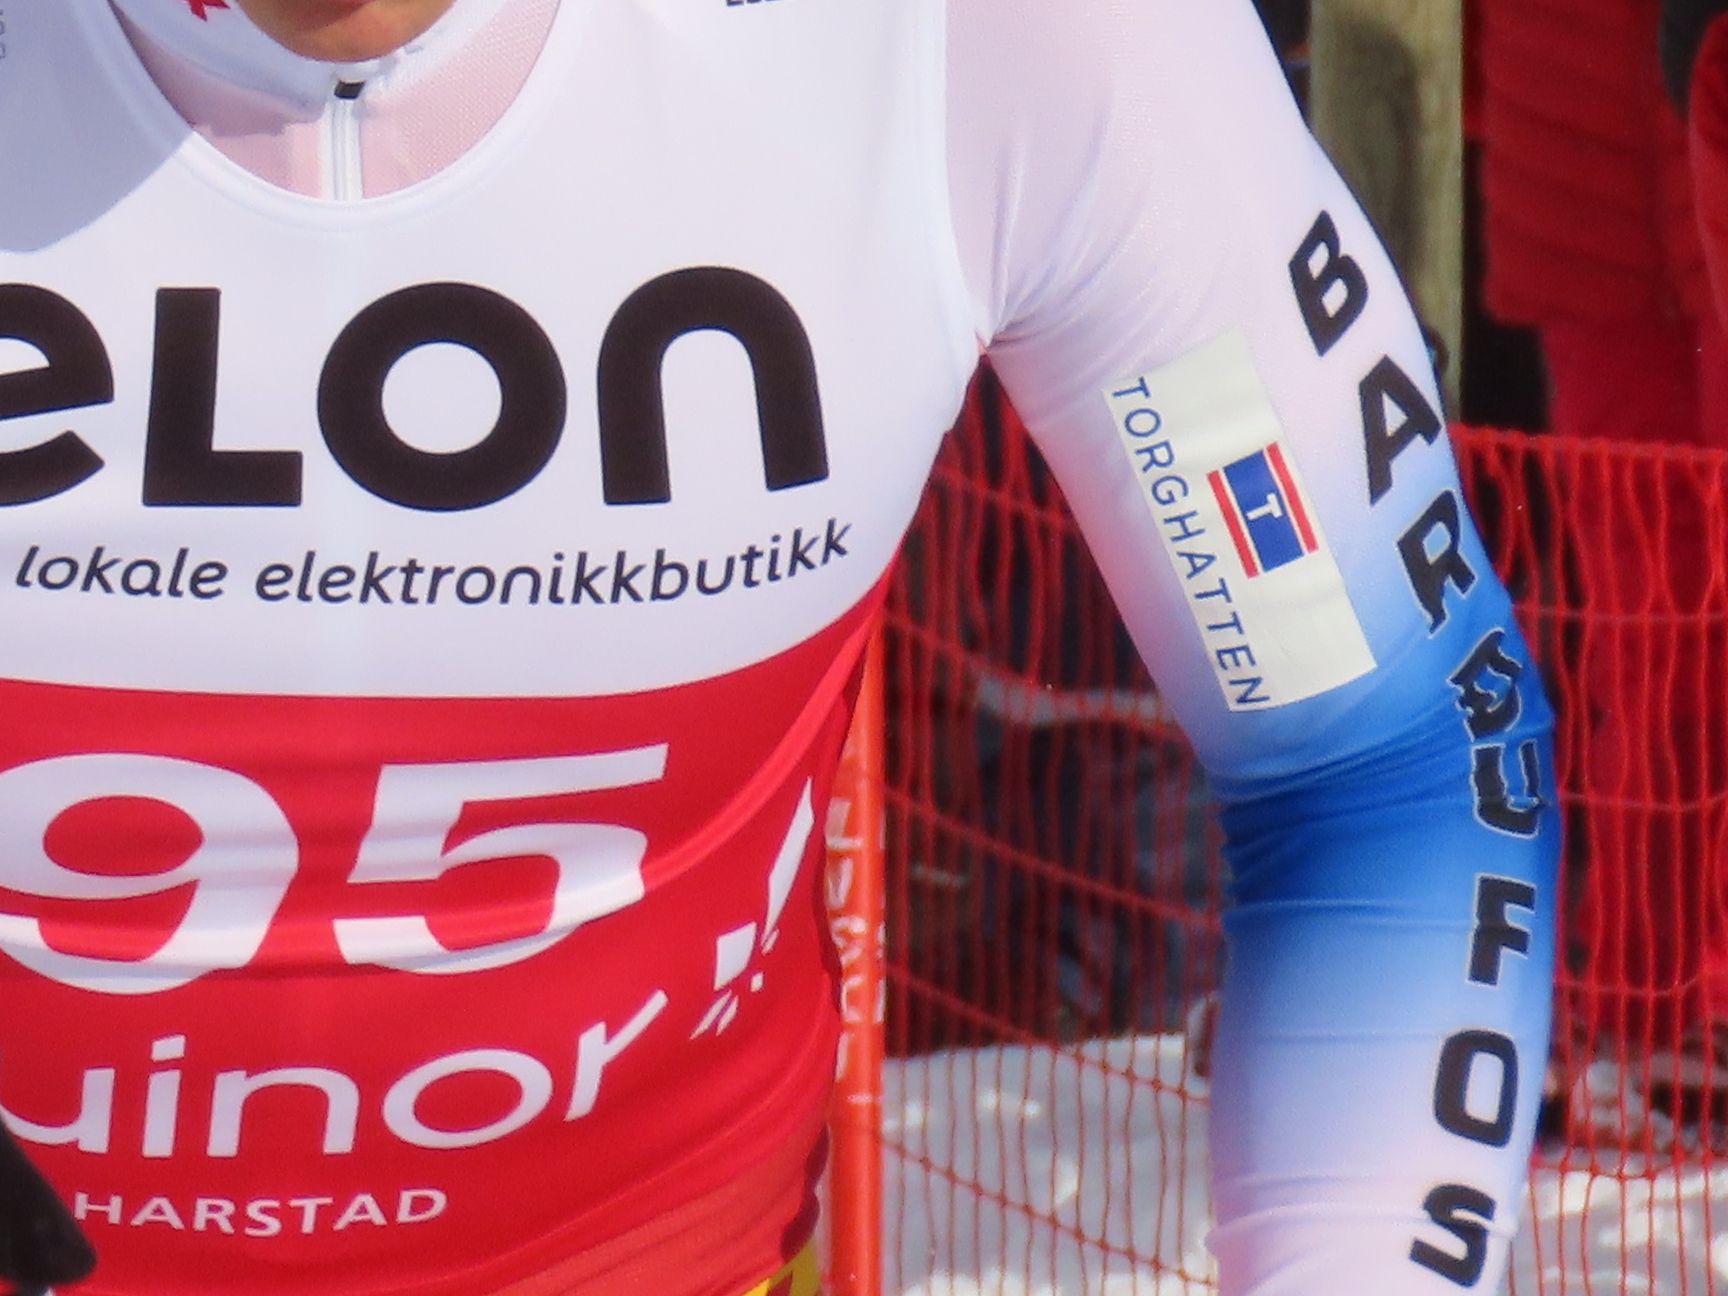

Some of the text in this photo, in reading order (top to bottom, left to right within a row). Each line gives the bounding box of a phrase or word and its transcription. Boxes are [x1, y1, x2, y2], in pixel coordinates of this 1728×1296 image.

[15, 543, 229, 602] lokale
[254, 517, 853, 607] elektronikkbutikk
[1112, 377, 1271, 709] TORGHATTEN
[73, 1187, 447, 1237] HARSTAD
